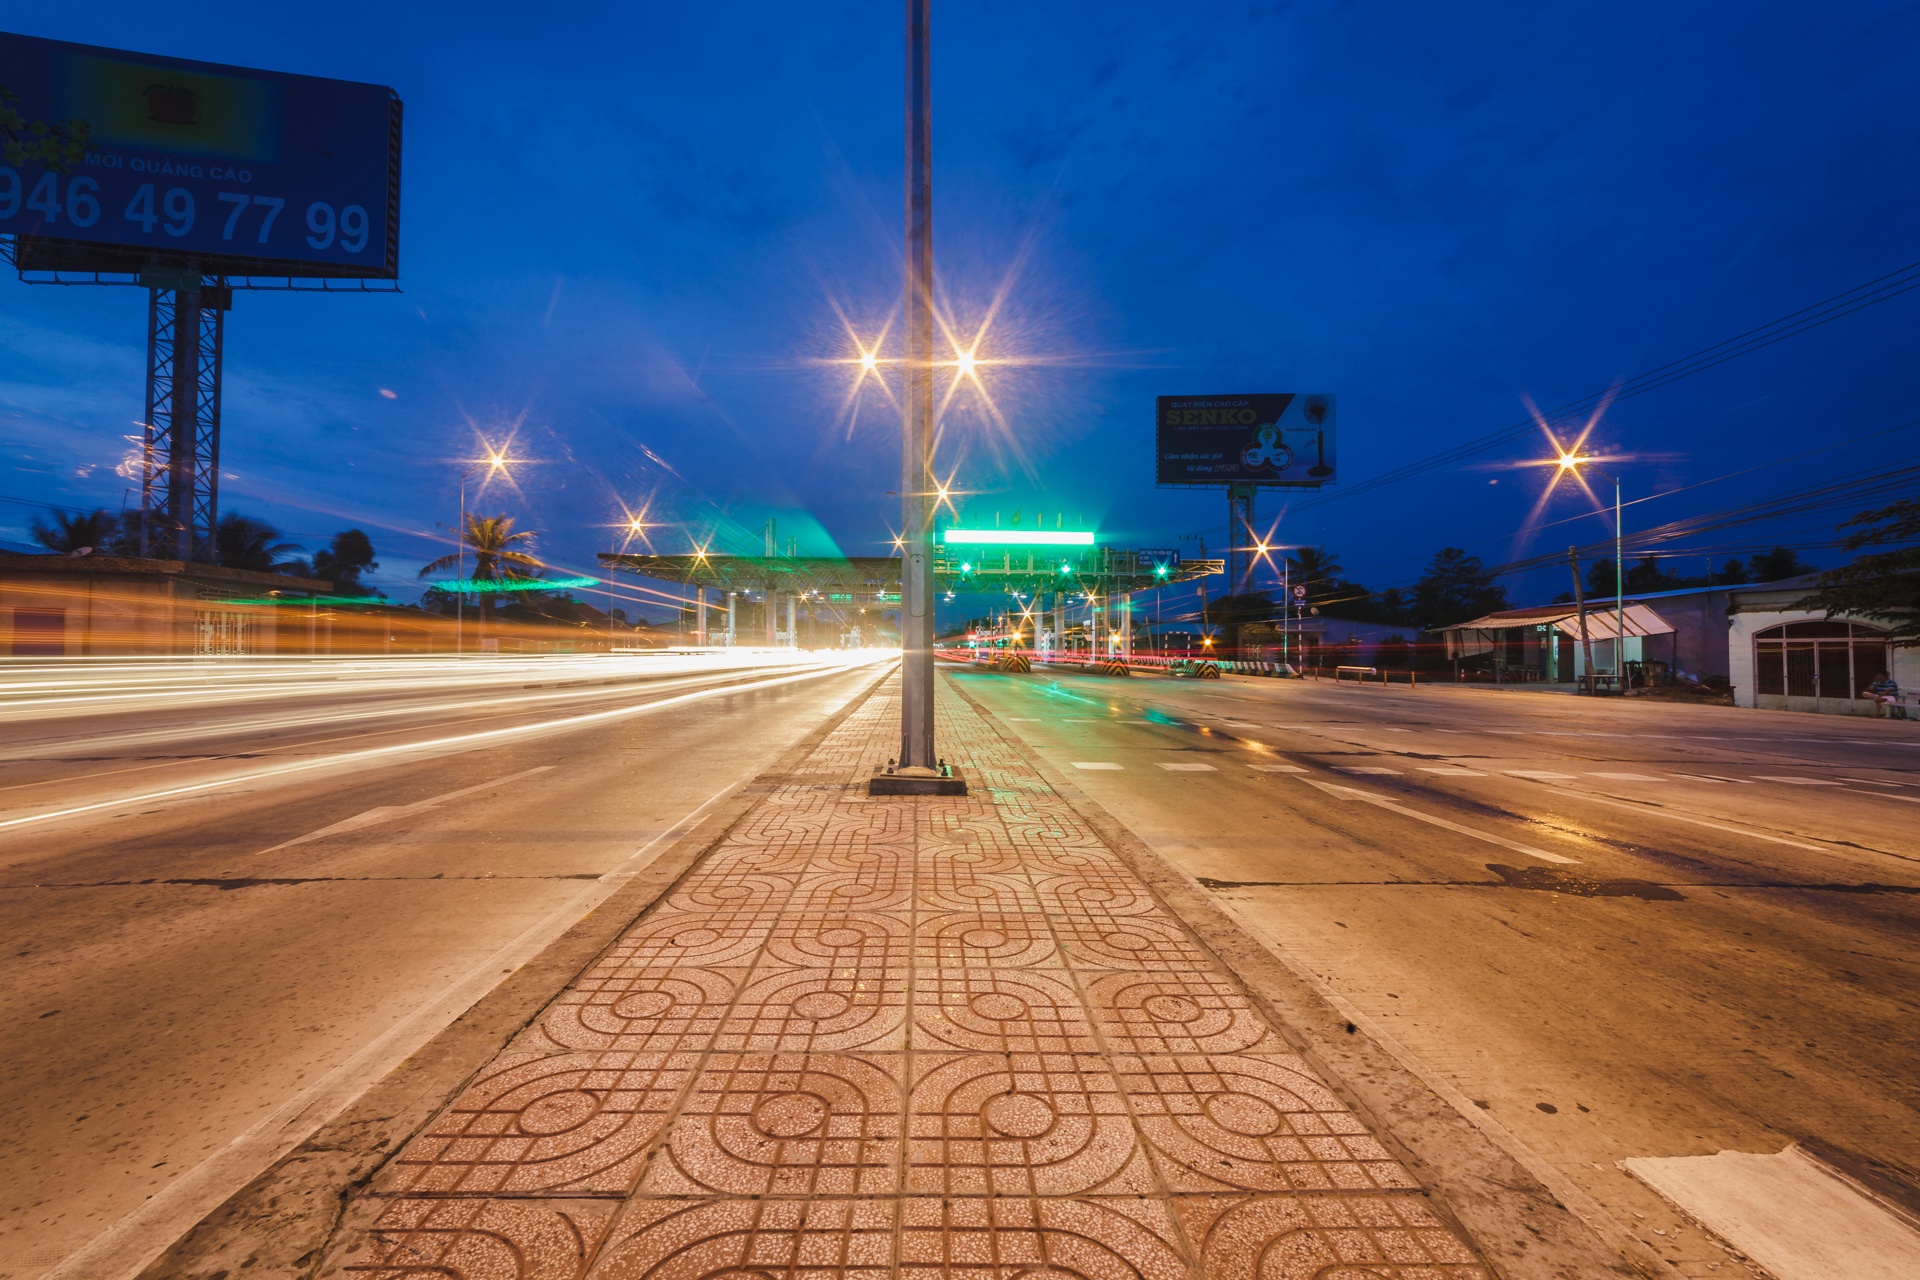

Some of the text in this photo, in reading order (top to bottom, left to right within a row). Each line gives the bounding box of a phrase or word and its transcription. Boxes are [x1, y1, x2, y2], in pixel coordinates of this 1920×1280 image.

[84, 150, 253, 183] MỜI QUẢNG CÁO
[0, 166, 370, 254] 946 49 77 99
[1166, 409, 1257, 425] SENKO
